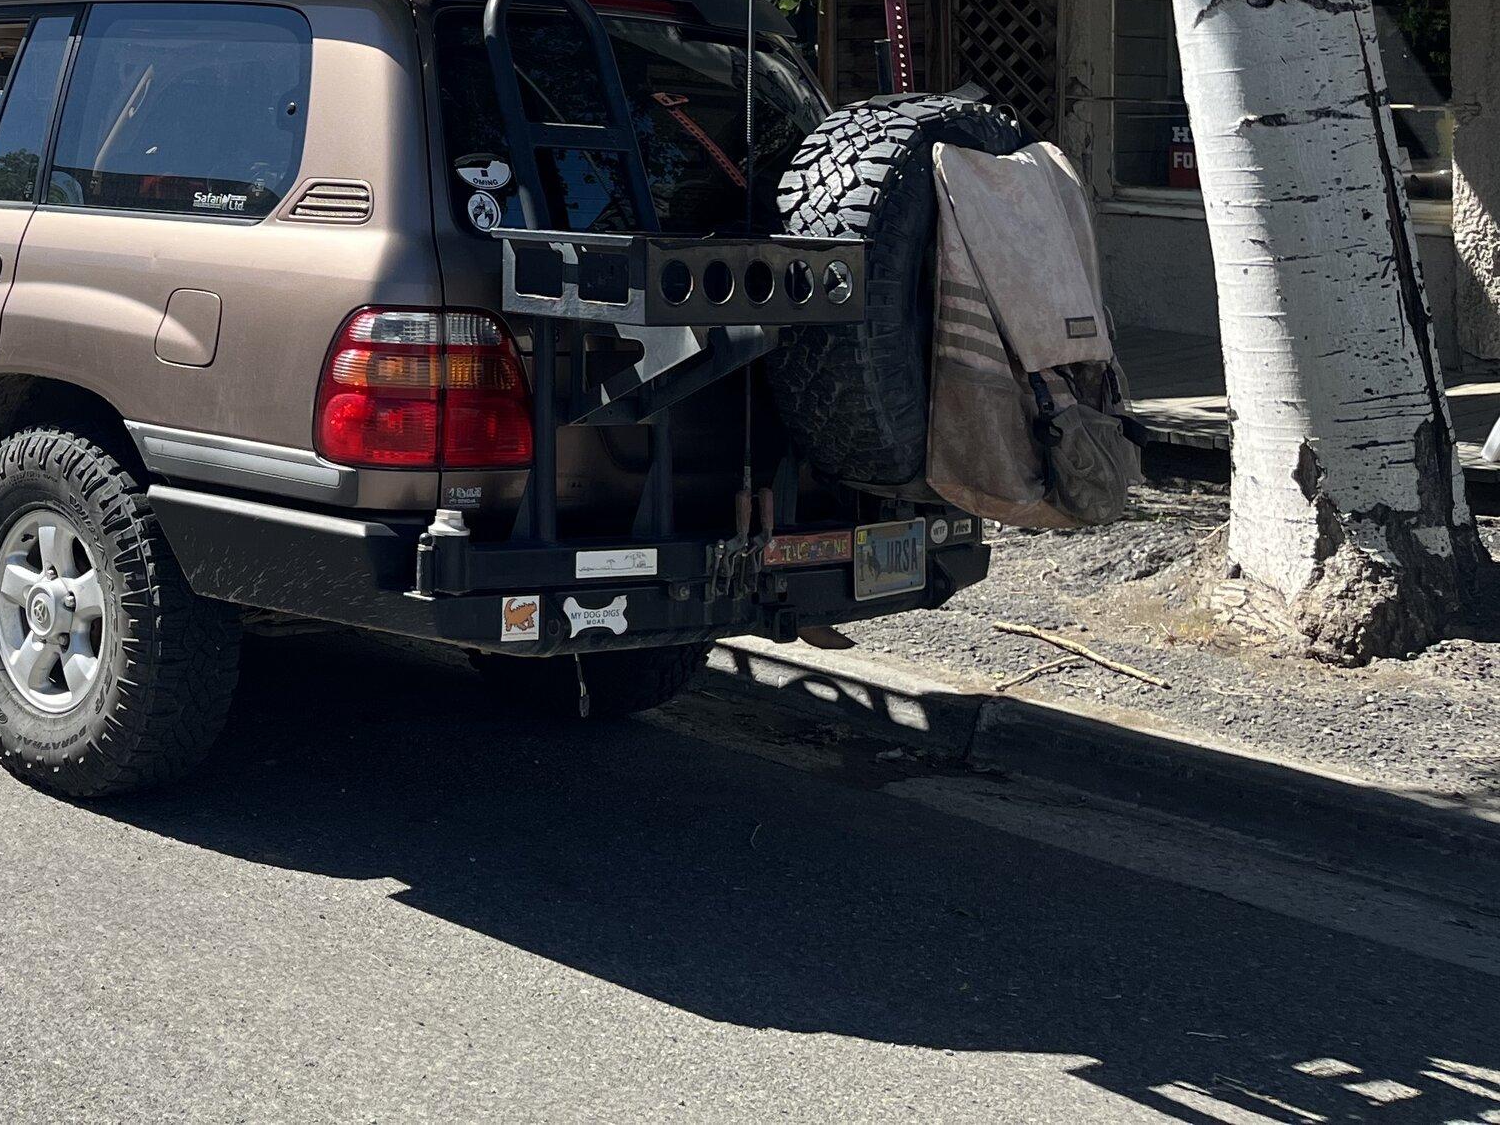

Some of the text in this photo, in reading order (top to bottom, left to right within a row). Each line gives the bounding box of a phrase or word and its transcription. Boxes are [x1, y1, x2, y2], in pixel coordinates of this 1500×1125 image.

[1173, 152, 1198, 169] FO
[194, 192, 222, 205] Safari
[886, 537, 919, 574] URSA
[571, 608, 620, 620] MY DOG DIGS
